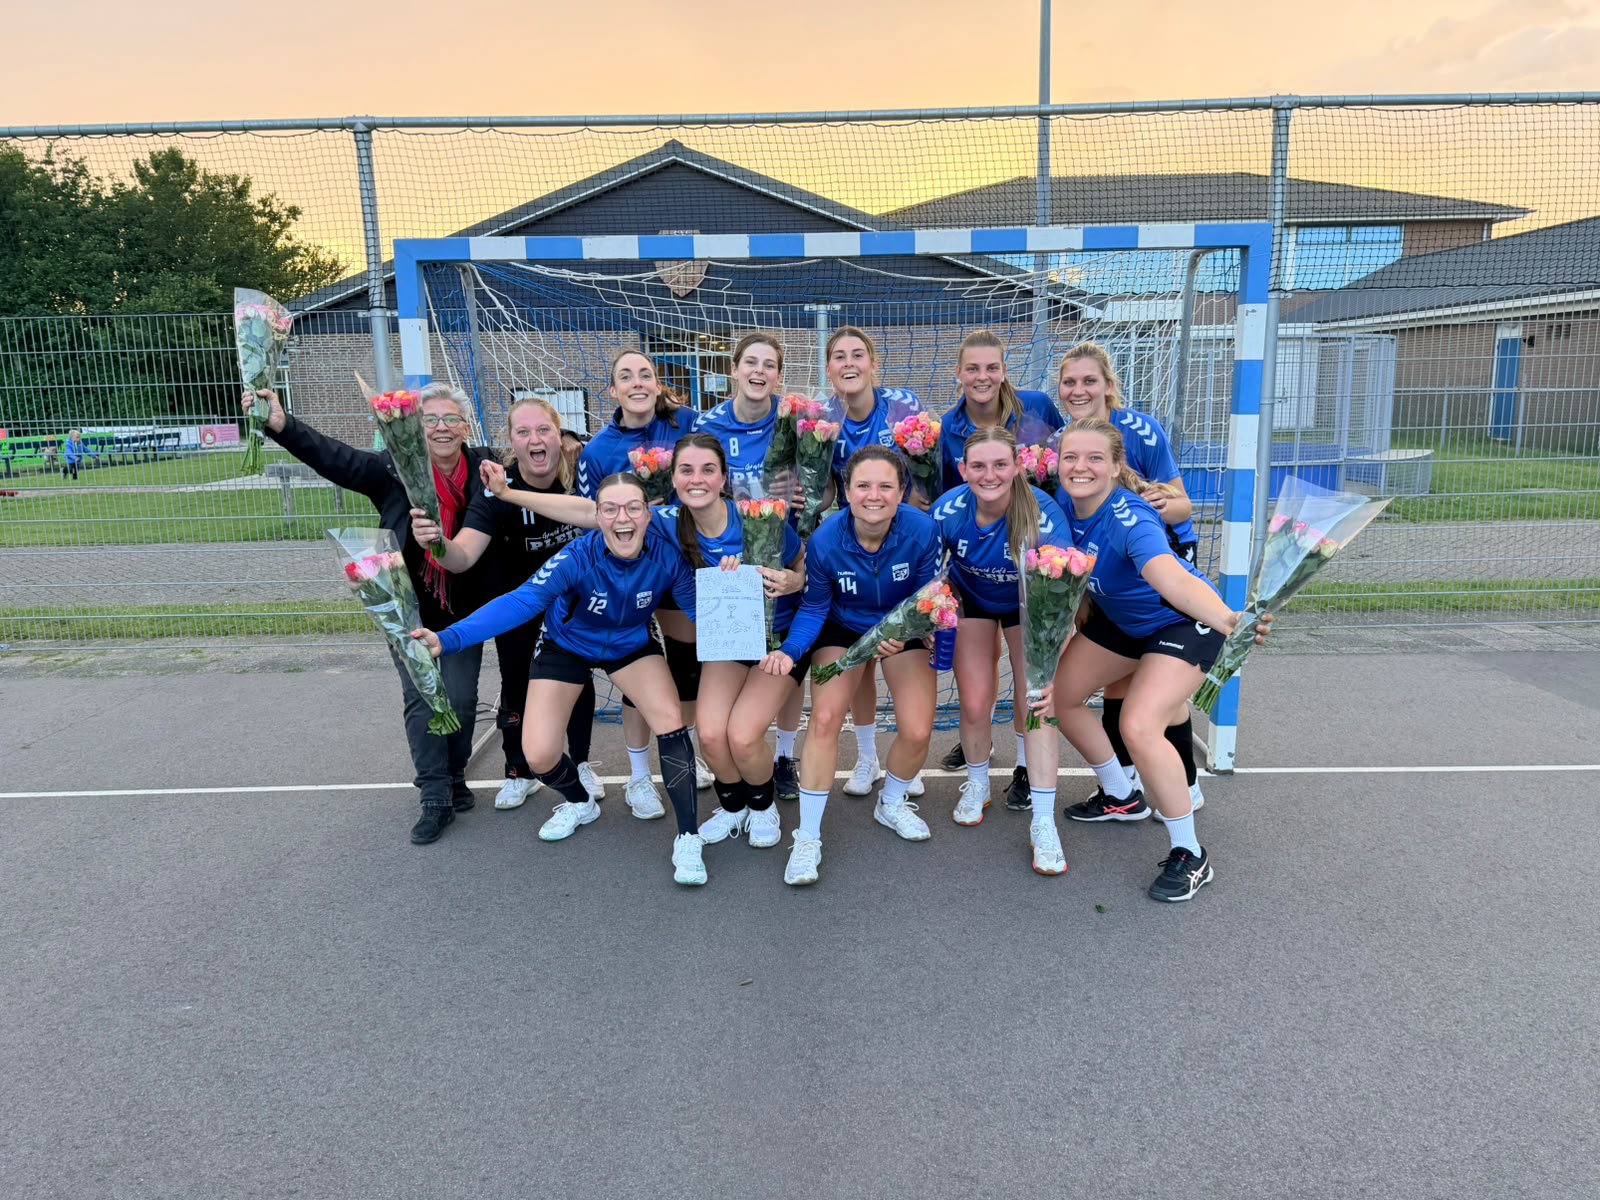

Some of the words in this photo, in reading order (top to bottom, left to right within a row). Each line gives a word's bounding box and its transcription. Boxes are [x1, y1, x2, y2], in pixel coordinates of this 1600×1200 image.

[729, 437, 740, 457] 8
[837, 439, 846, 458] 7
[957, 538, 969, 558] 5
[838, 577, 857, 595] 14
[586, 596, 608, 615] 12
